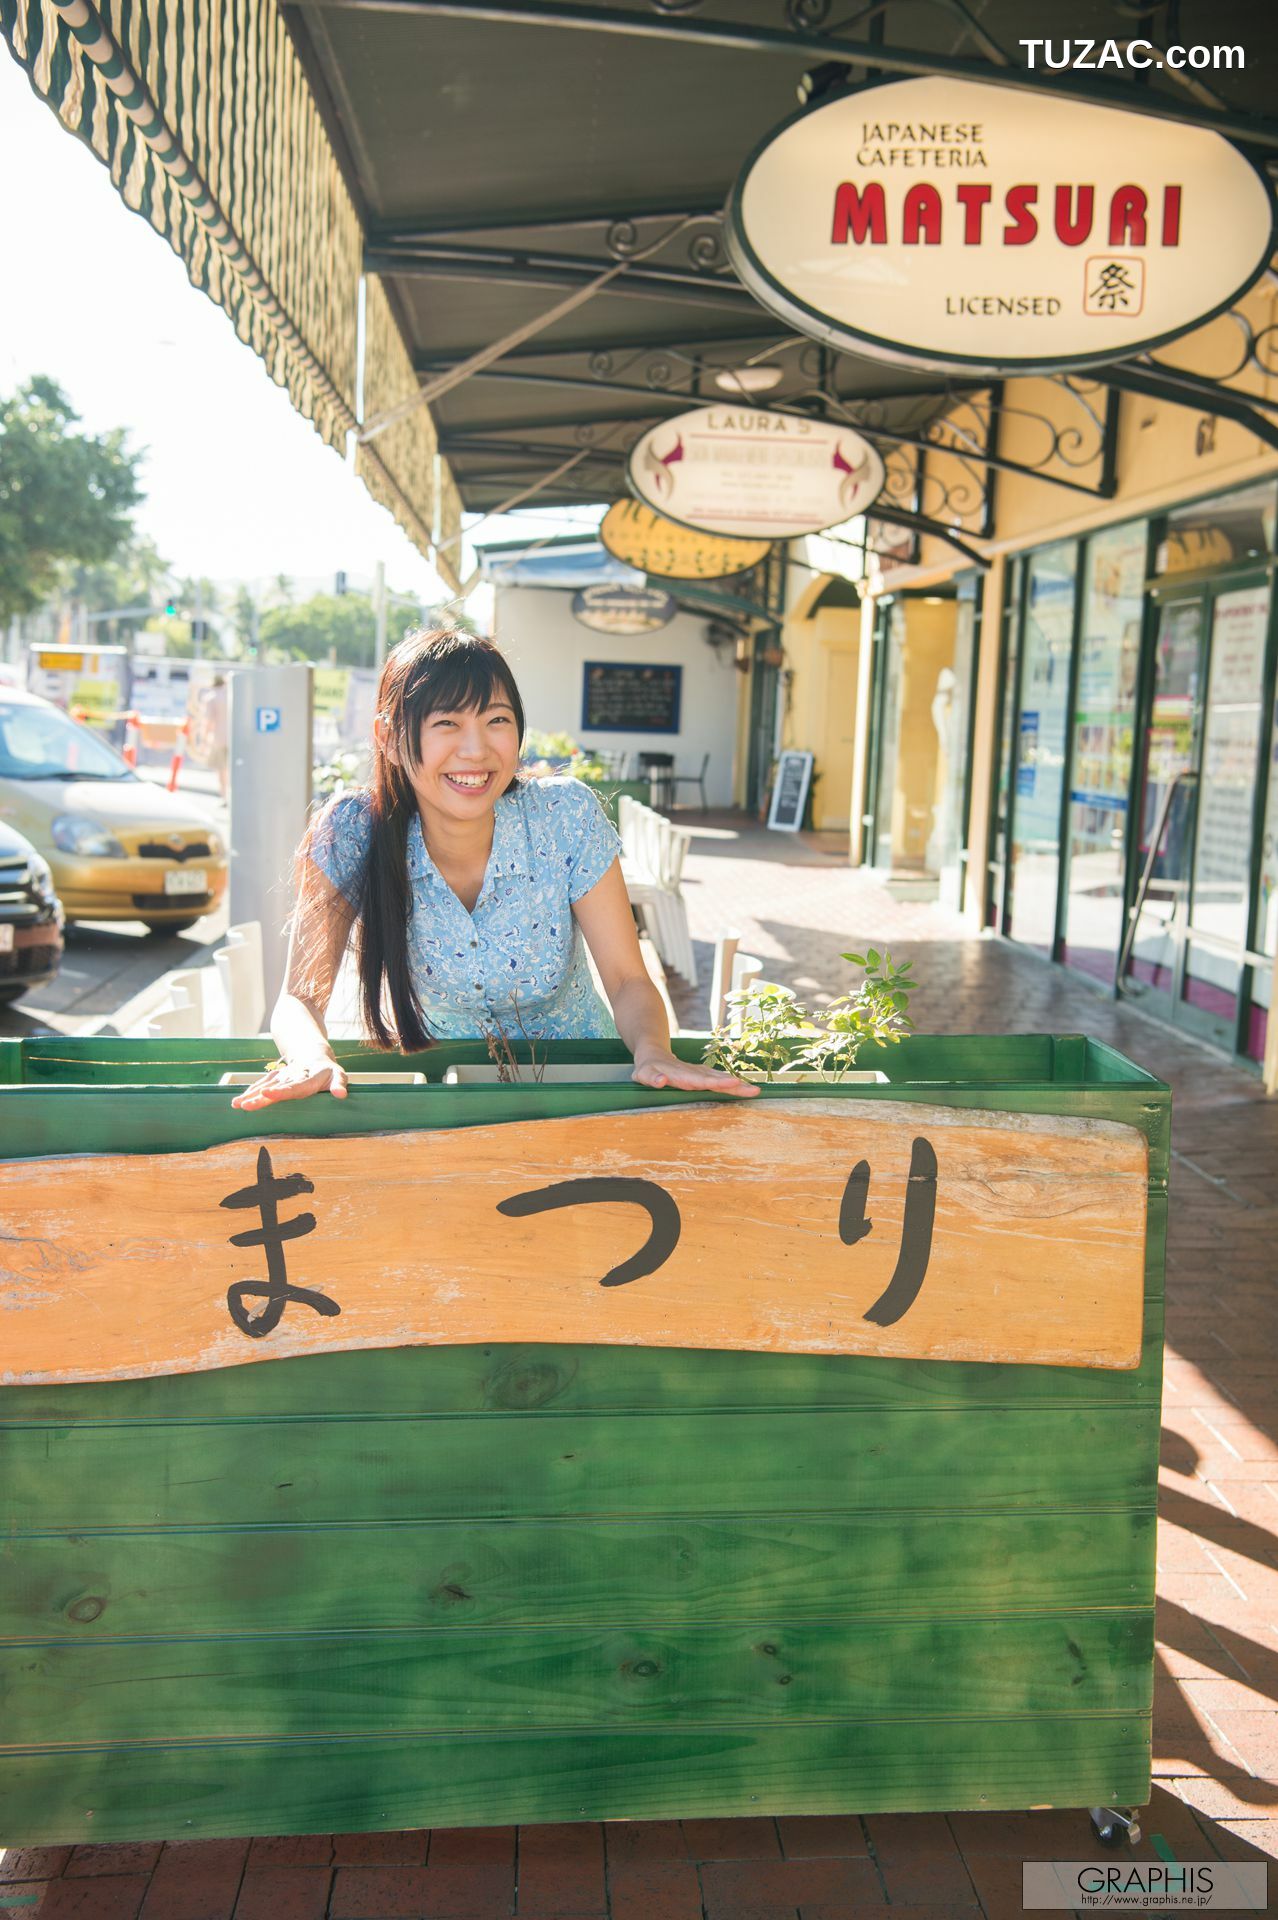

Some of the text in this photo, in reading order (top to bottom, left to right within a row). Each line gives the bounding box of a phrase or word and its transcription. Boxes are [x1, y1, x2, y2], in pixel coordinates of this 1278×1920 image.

[862, 123, 984, 144] JAPANESE
[856, 148, 988, 168] CAFETERIA
[831, 181, 1184, 247] MATSURI
[1089, 263, 1135, 310] 祭
[945, 296, 1062, 316] LICENSED
[706, 411, 812, 434] LAURAS
